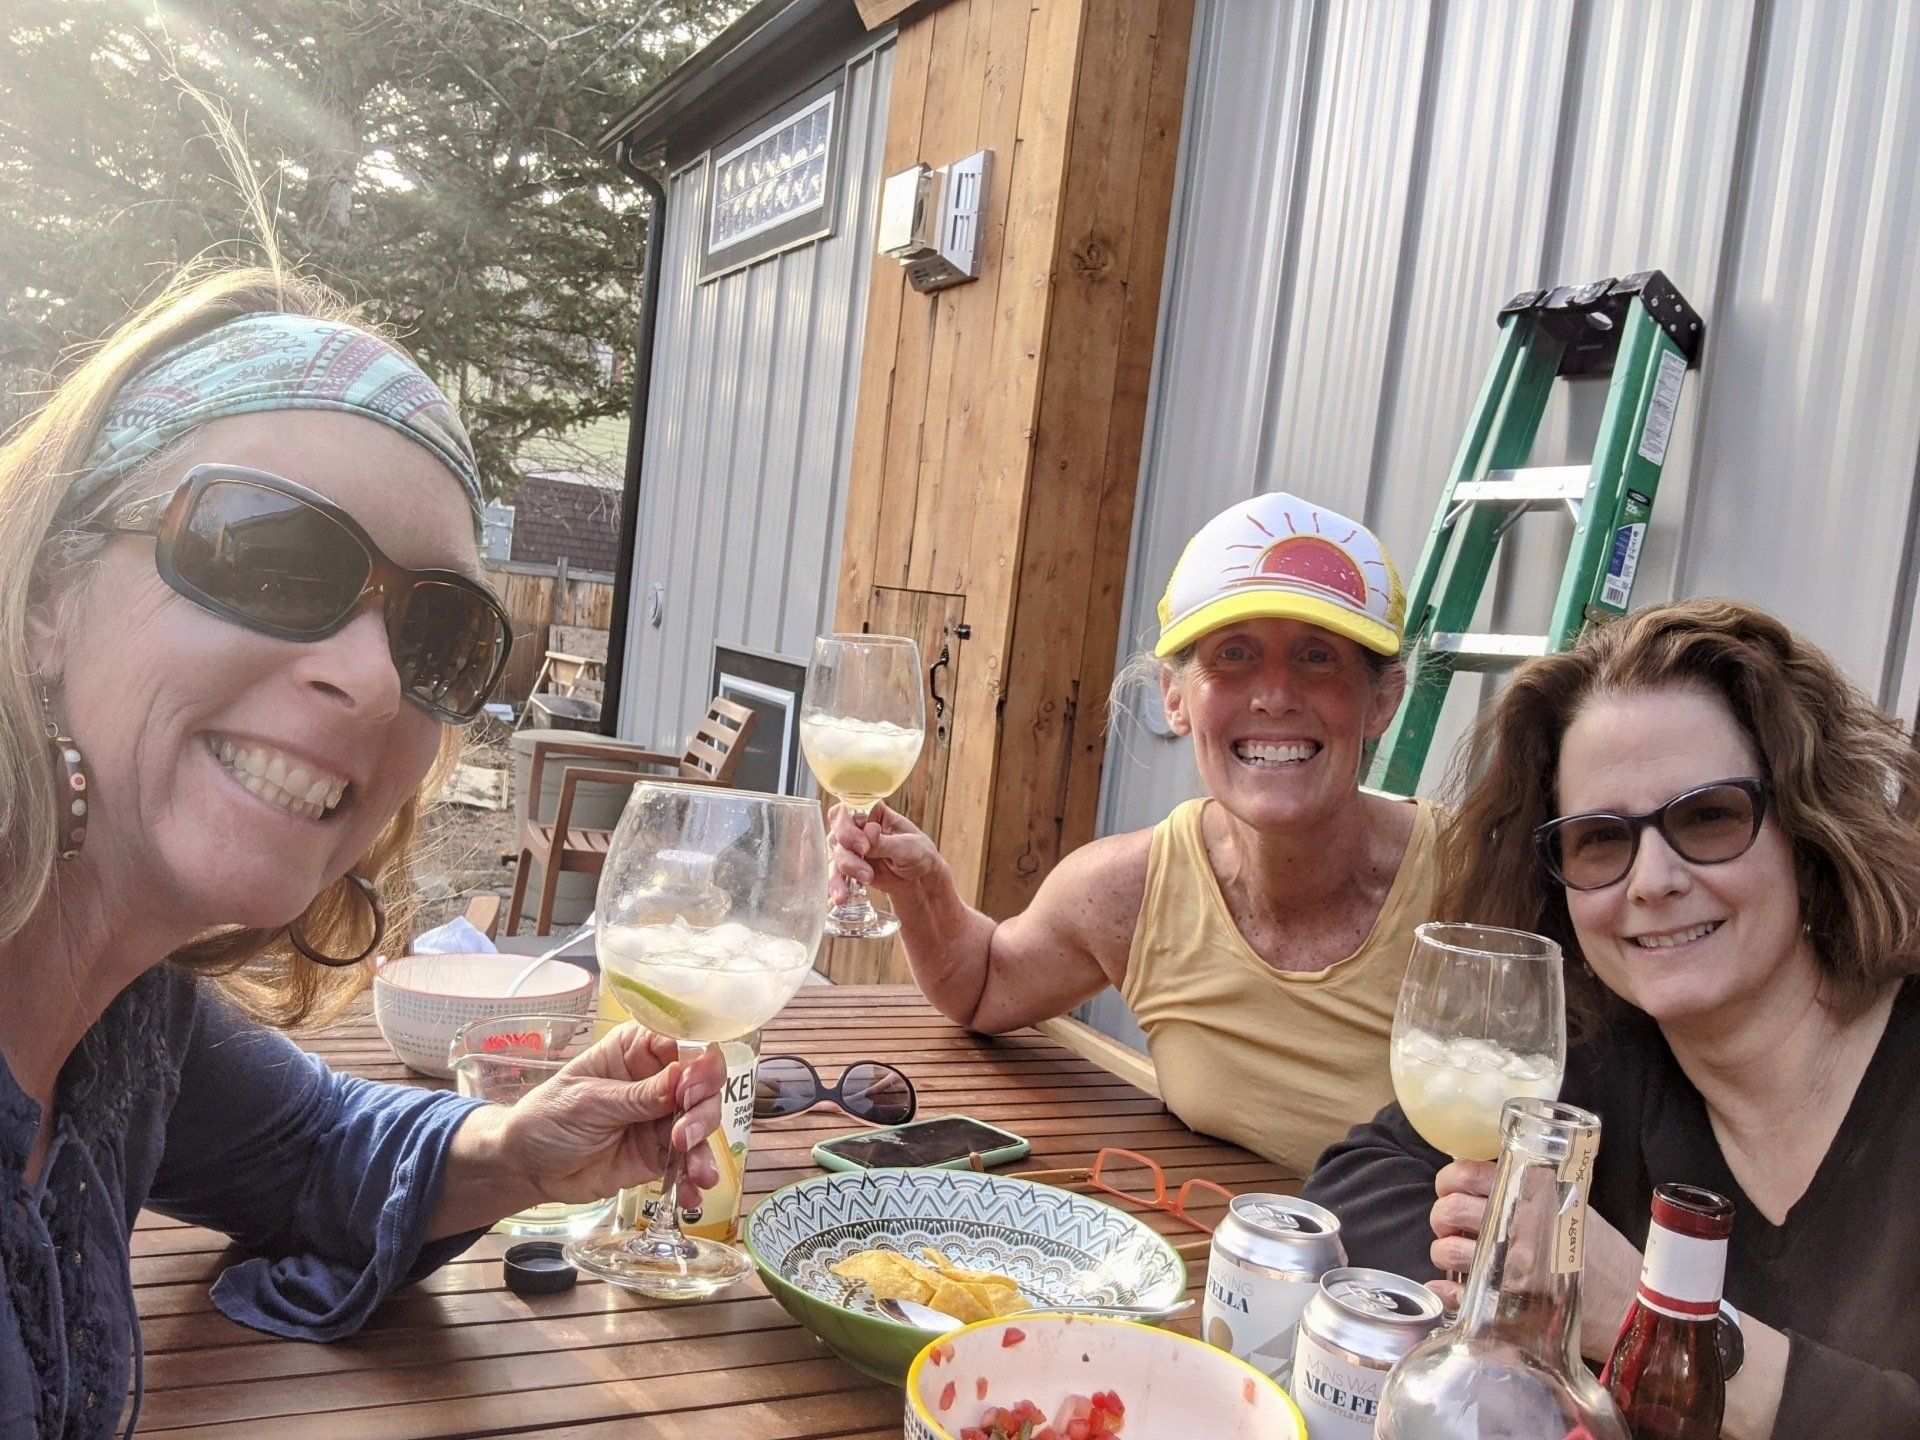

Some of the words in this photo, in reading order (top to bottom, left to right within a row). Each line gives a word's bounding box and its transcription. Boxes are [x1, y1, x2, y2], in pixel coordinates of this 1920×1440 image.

[724, 1068, 755, 1104] KEV
[1575, 1150, 1592, 1182] 100%
[1208, 1275, 1249, 1314] FELLA
[1303, 1369, 1347, 1408] NICE
[1350, 1395, 1379, 1417] FE
[1346, 1374, 1379, 1399] WA
